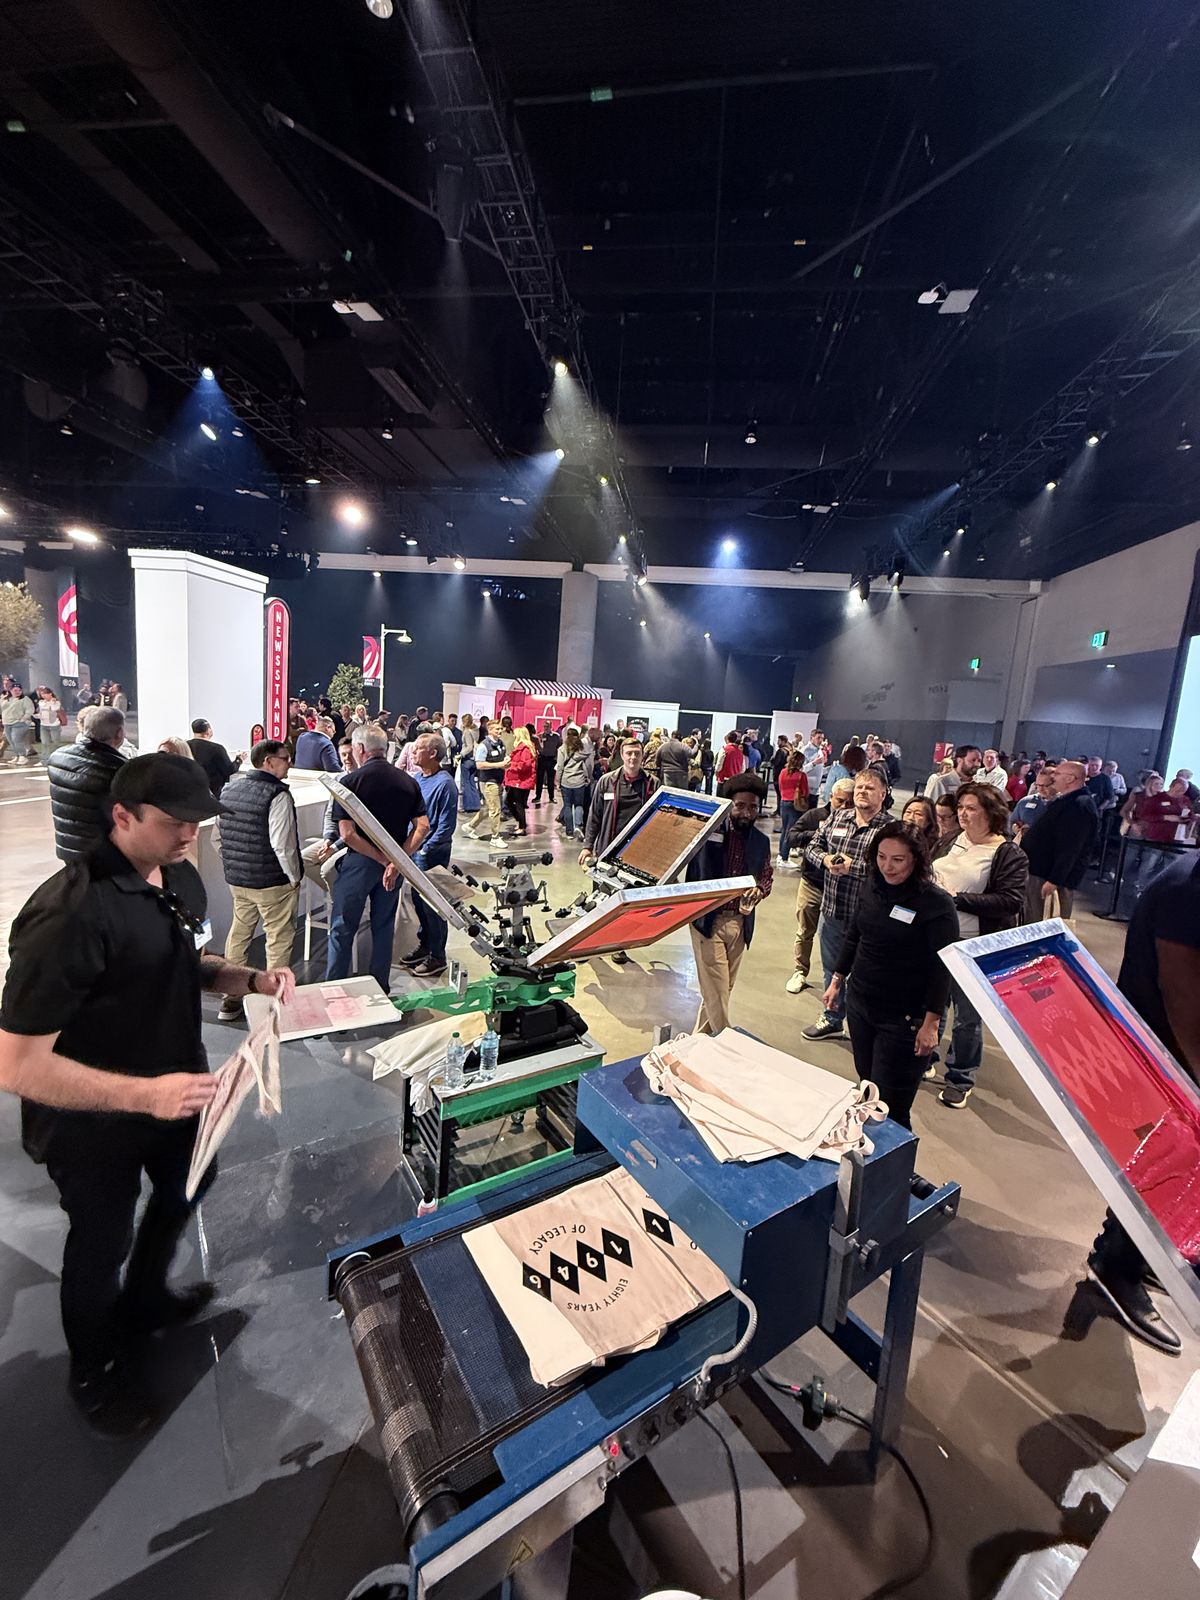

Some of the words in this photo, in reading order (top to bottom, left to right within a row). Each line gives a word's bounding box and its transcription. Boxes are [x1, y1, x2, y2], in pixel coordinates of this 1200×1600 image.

[273, 611, 282, 738] NEWSSTAND
[529, 1225, 567, 1256] LEGACY
[571, 1223, 586, 1235] OF
[603, 1278, 629, 1306] EIGHTY
[566, 1302, 601, 1313] YEARS
